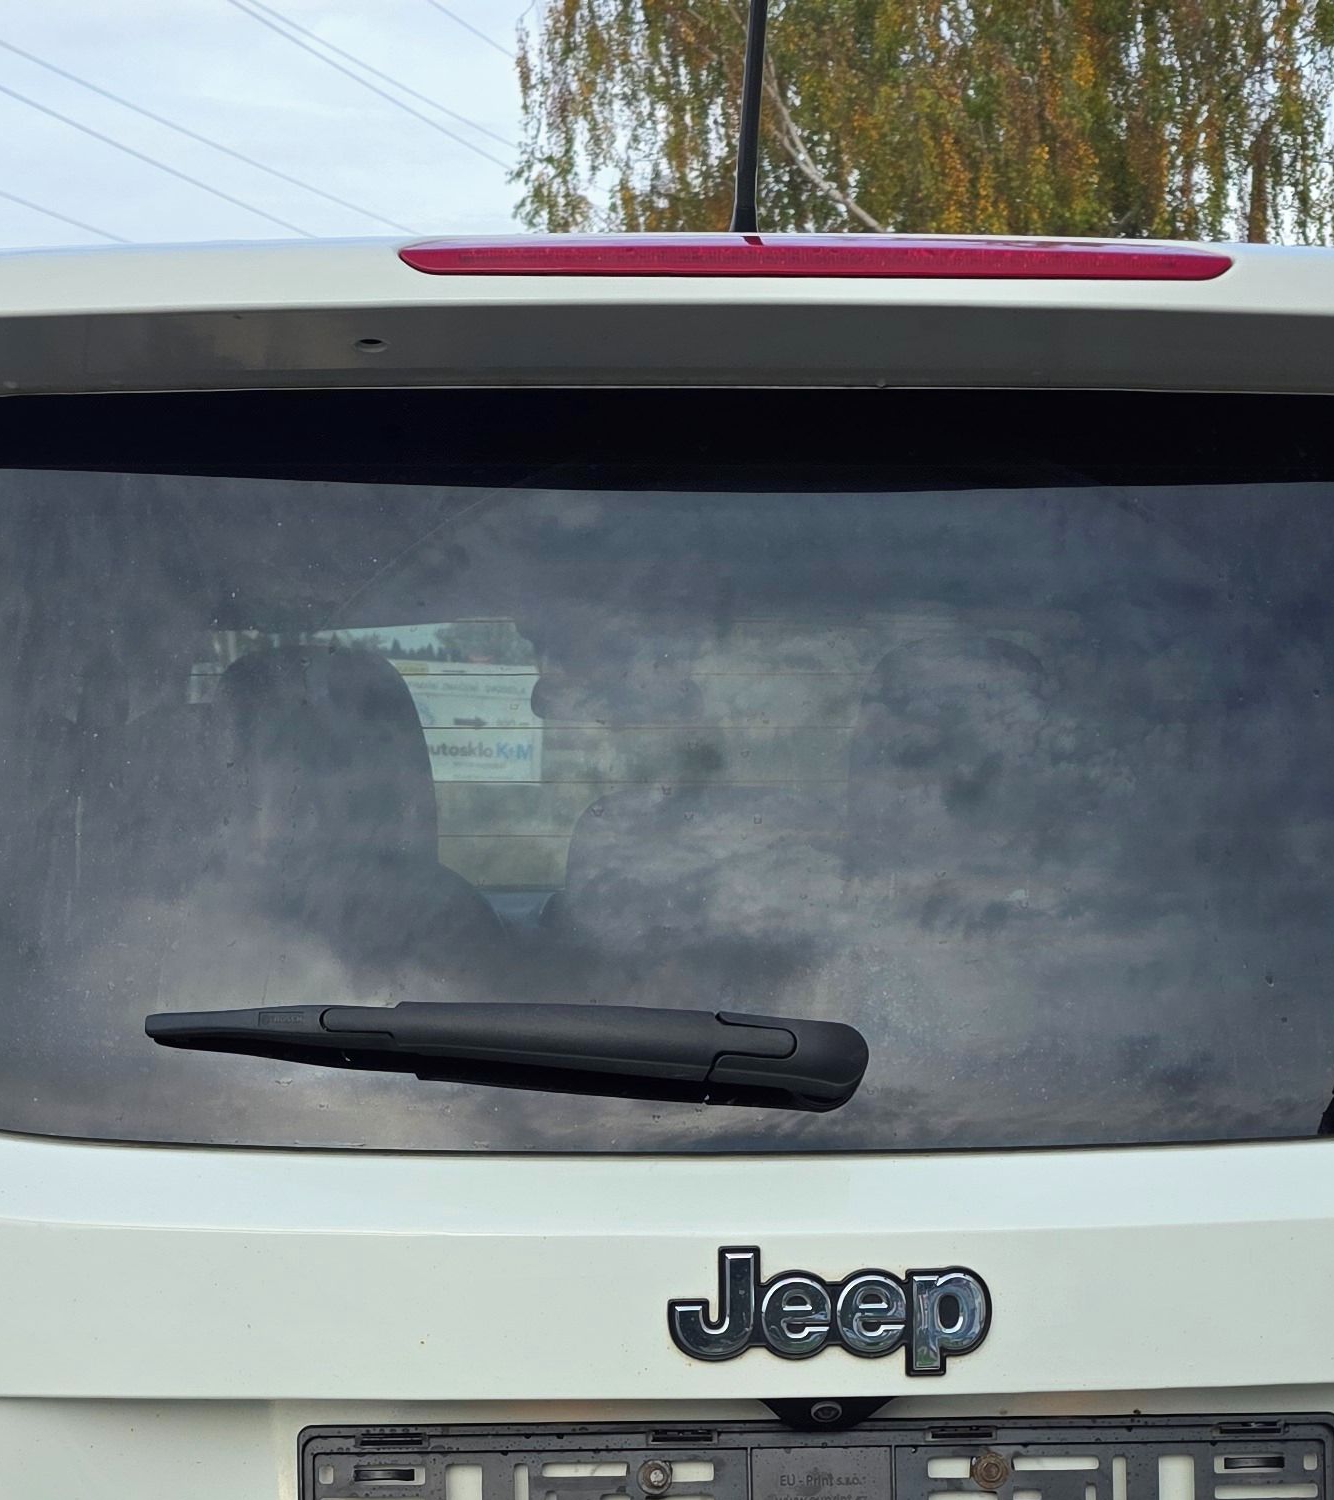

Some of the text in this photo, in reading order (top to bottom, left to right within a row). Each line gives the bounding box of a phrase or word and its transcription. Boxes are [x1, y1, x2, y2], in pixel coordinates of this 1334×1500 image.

[667, 1246, 993, 1377] Jeep
[779, 1474, 796, 1487] EU
[806, 1472, 835, 1487] Print
